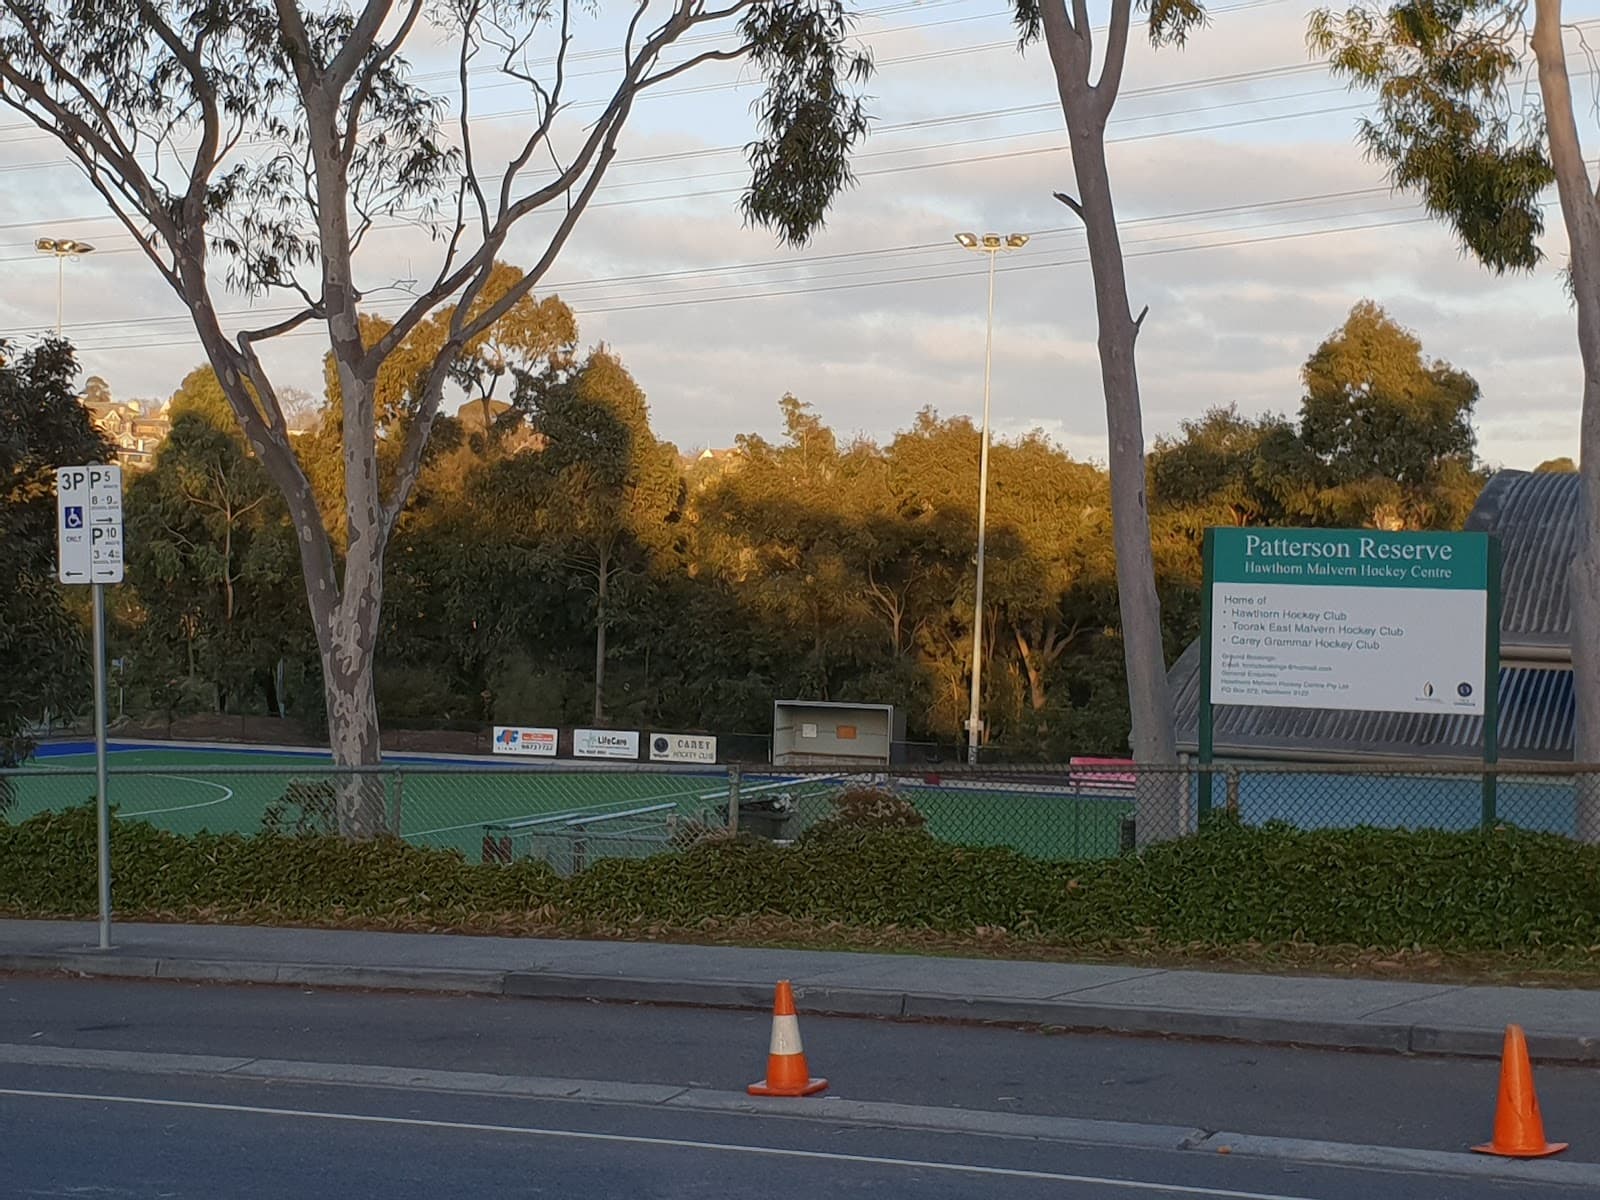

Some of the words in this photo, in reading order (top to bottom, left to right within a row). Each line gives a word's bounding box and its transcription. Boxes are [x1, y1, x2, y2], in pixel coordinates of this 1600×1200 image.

[62, 472, 84, 491] 3P
[90, 472, 101, 490] P
[104, 471, 110, 482] 5
[92, 528, 103, 545] P
[106, 528, 116, 538] 10
[94, 550, 100, 559] 3
[108, 550, 114, 558] 4
[1245, 535, 1350, 558] Patterson
[1359, 538, 1453, 561] Reserve
[1245, 561, 1302, 574] Hawthorn
[1307, 563, 1356, 576] Malvern
[1361, 564, 1406, 580] Hockey
[1410, 565, 1452, 579] Centre
[1224, 595, 1254, 605] Home
[1257, 596, 1267, 605] of
[1232, 608, 1280, 619] Hawthorn
[1283, 610, 1320, 622] Hockey
[1323, 611, 1347, 621] Club
[1233, 621, 1265, 631] Toorak
[1269, 623, 1292, 632] East
[1294, 624, 1336, 634] Malvern
[1338, 625, 1376, 638] Hockey
[1379, 627, 1403, 637] Club
[1231, 635, 1261, 648] Carey
[1264, 637, 1311, 648] Grammar
[1315, 638, 1353, 650] Hockey
[1356, 640, 1380, 650] Club
